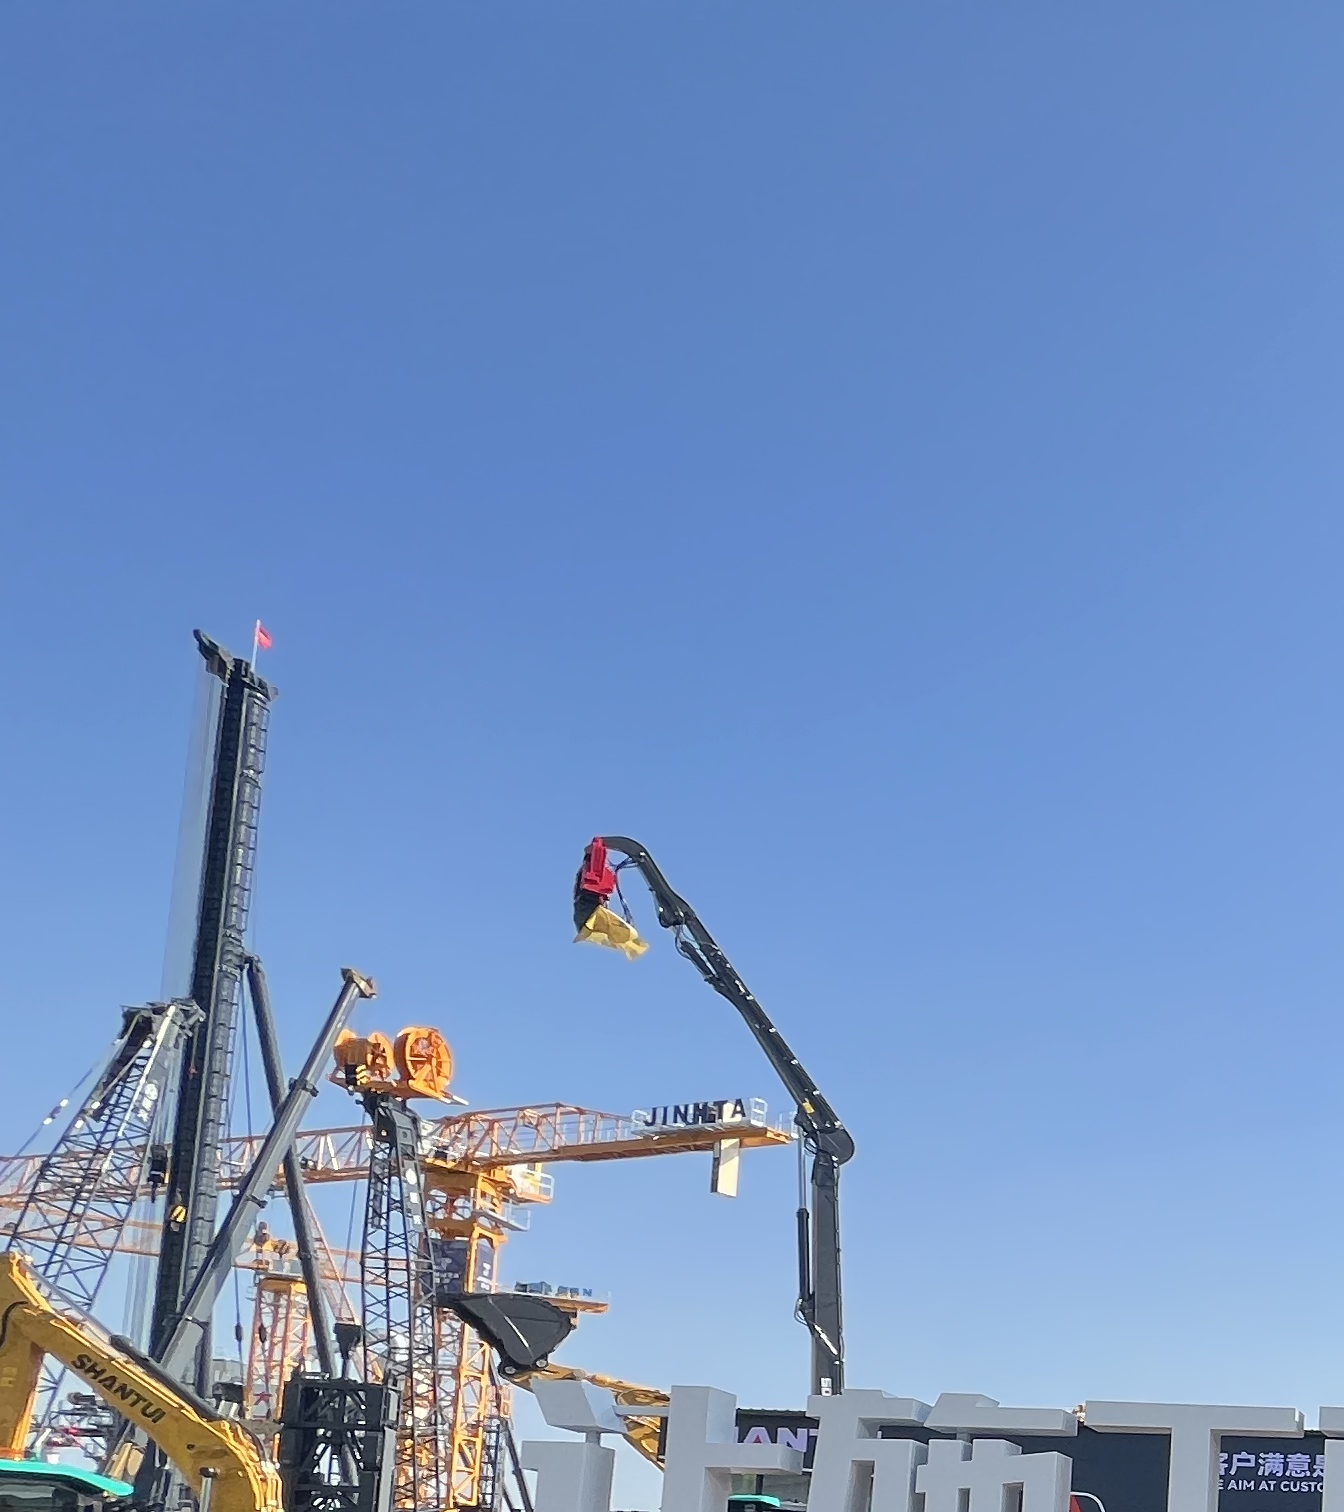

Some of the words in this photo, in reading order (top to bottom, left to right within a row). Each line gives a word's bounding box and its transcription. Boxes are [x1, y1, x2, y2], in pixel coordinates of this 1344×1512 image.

[70, 1353, 166, 1424] SHANTUI
[1227, 1479, 1255, 1491] AIM
[1258, 1480, 1277, 1492] AT
